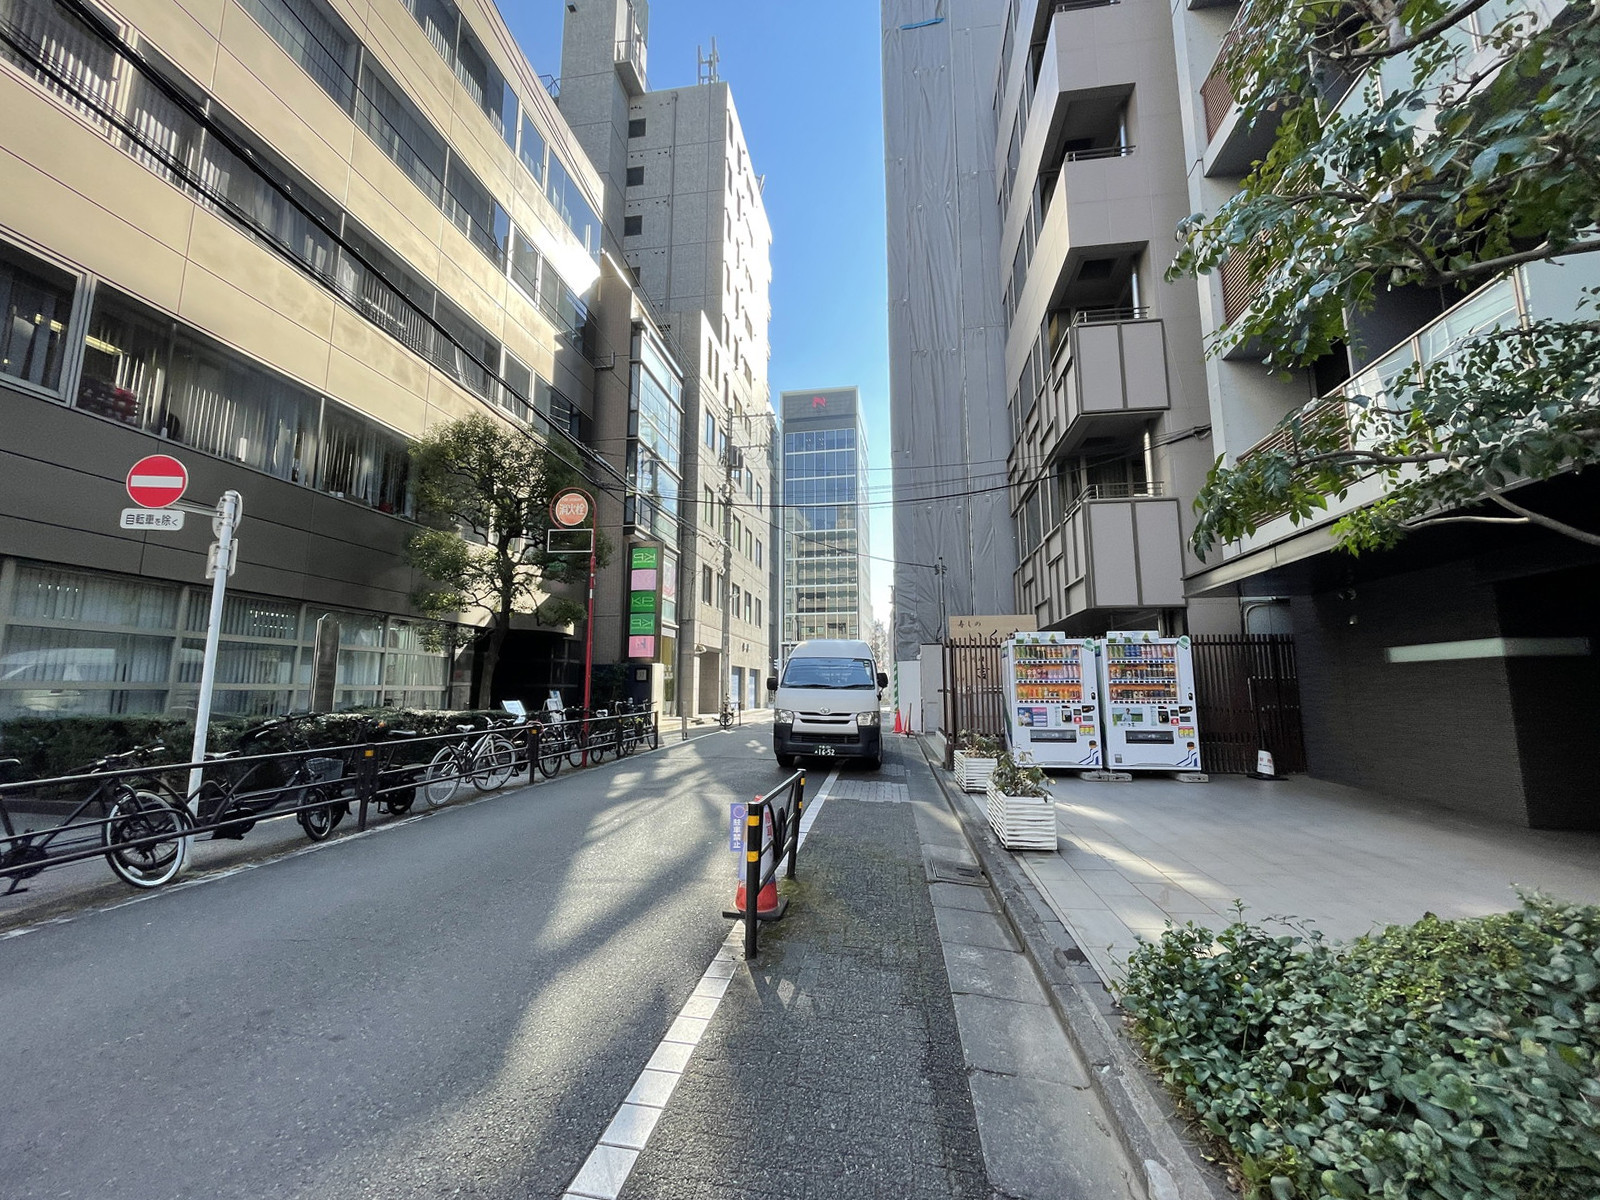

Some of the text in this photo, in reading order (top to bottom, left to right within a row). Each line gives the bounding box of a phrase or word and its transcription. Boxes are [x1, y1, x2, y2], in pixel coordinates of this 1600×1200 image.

[559, 503, 585, 515] 消火栓
[125, 514, 178, 527] 自転車を除く
